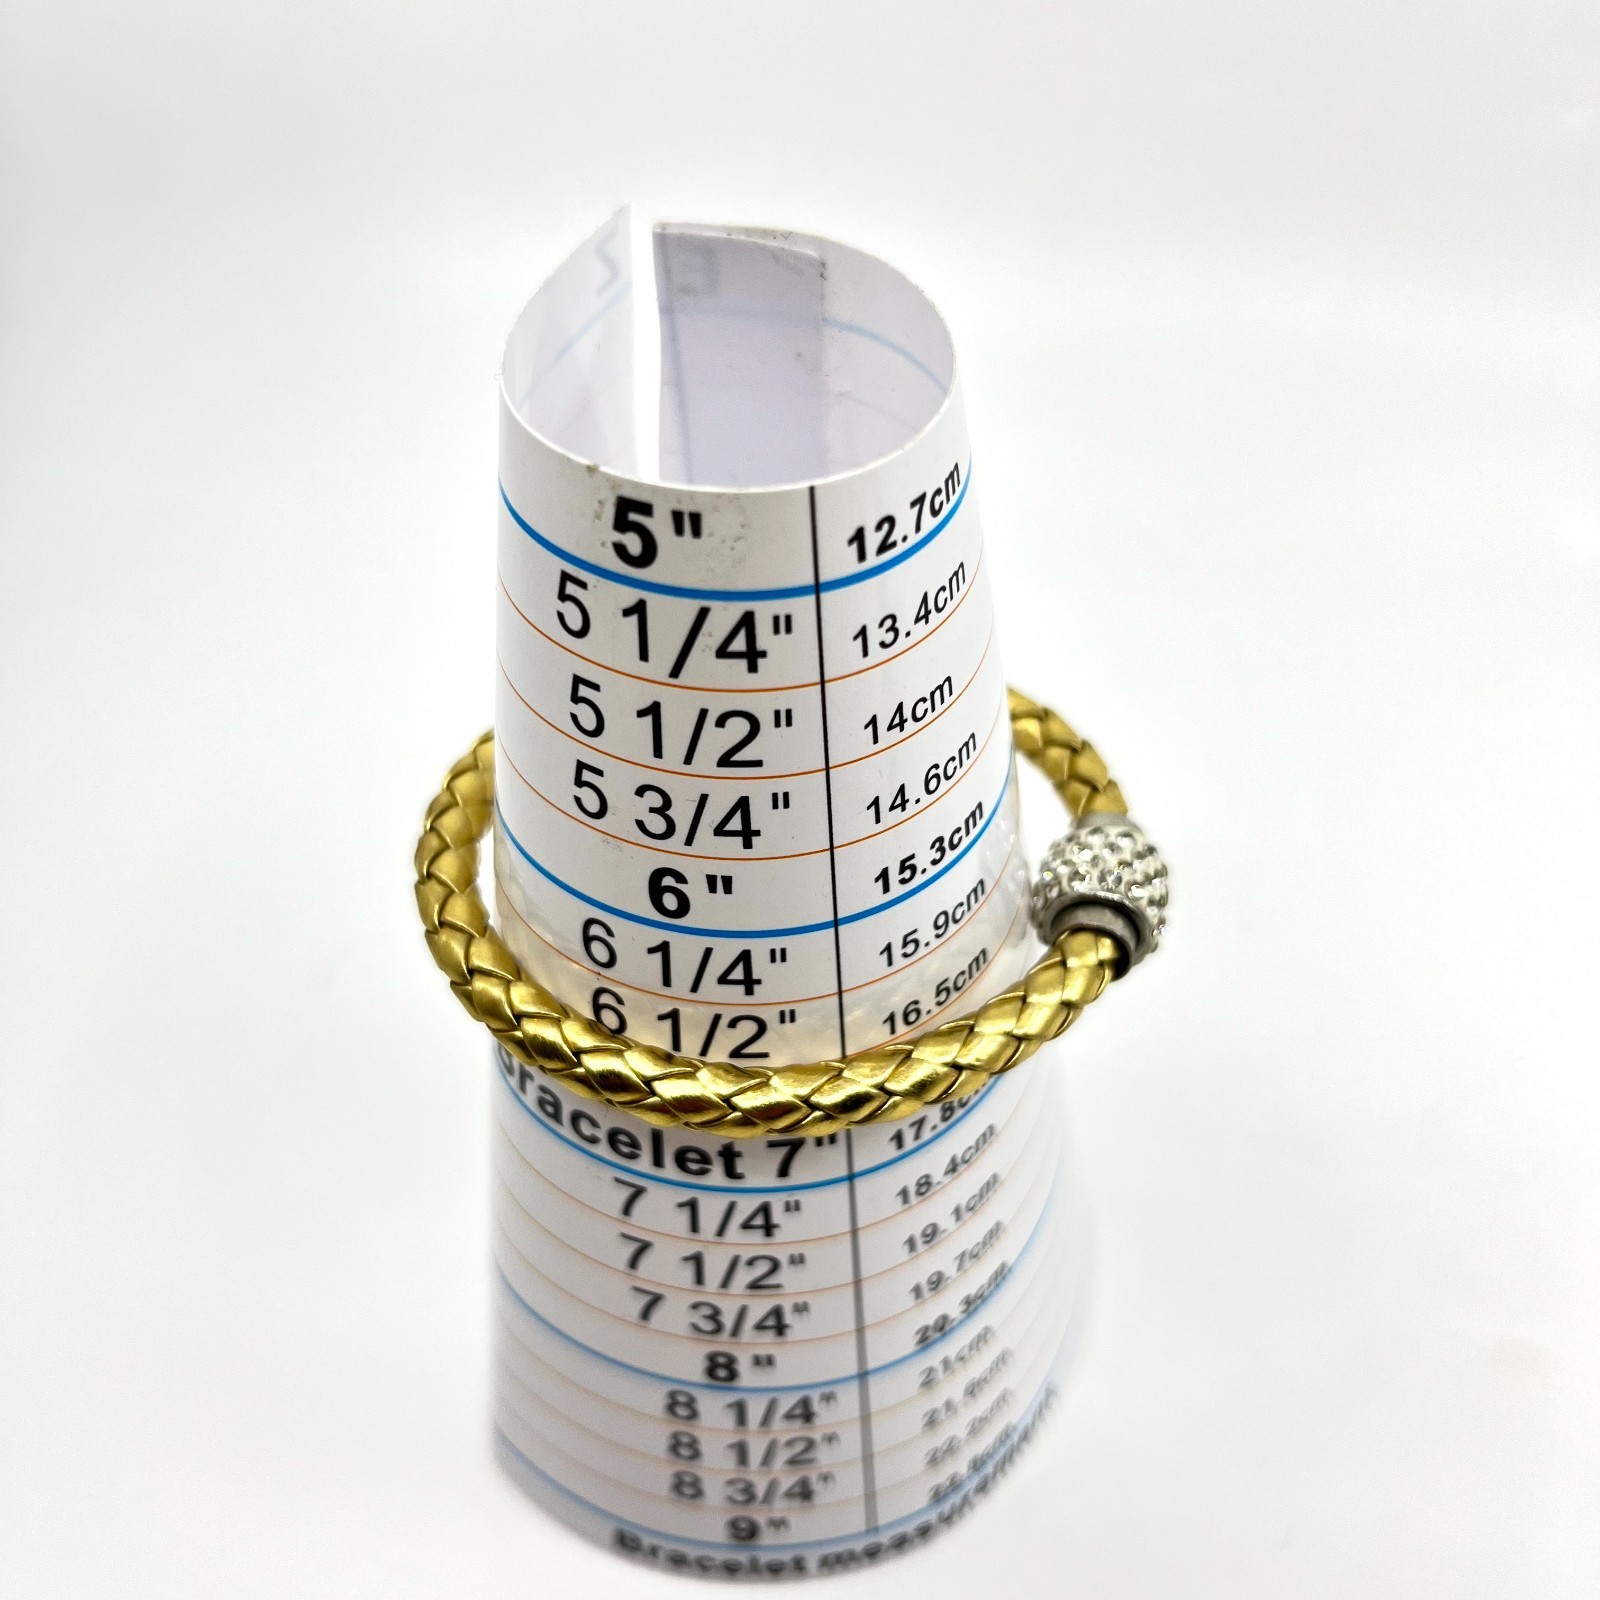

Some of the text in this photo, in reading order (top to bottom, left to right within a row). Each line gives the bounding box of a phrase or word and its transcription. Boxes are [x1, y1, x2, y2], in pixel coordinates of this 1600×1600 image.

[846, 462, 962, 564] 12.7cm
[556, 570, 793, 680] 5 1/4"
[852, 561, 967, 659] 13.4cm
[568, 673, 793, 769] 5 1/2"
[863, 675, 954, 746] 14cm
[573, 759, 790, 850] 5 3/4"
[866, 731, 977, 825] 14.6cm
[873, 800, 984, 894] 15.3cm
[582, 917, 788, 997] 6 1/4"
[878, 877, 986, 968] 15.9cm
[591, 986, 797, 1059] 6 1/2"
[881, 947, 988, 1036] 16.5cm
[895, 1123, 997, 1206] 18.4cm
[613, 1177, 801, 1239] 7 1/4"
[903, 1172, 1001, 1255] 19.1cm
[619, 1232, 806, 1292] 7 1/2"
[909, 1220, 1006, 1301] 19.7cm
[631, 1286, 810, 1340] 7 3/4"
[665, 1388, 699, 1424] 8
[666, 1430, 700, 1465] 8
[670, 1469, 706, 1503] 8
[614, 1526, 808, 1579] Bracelet
